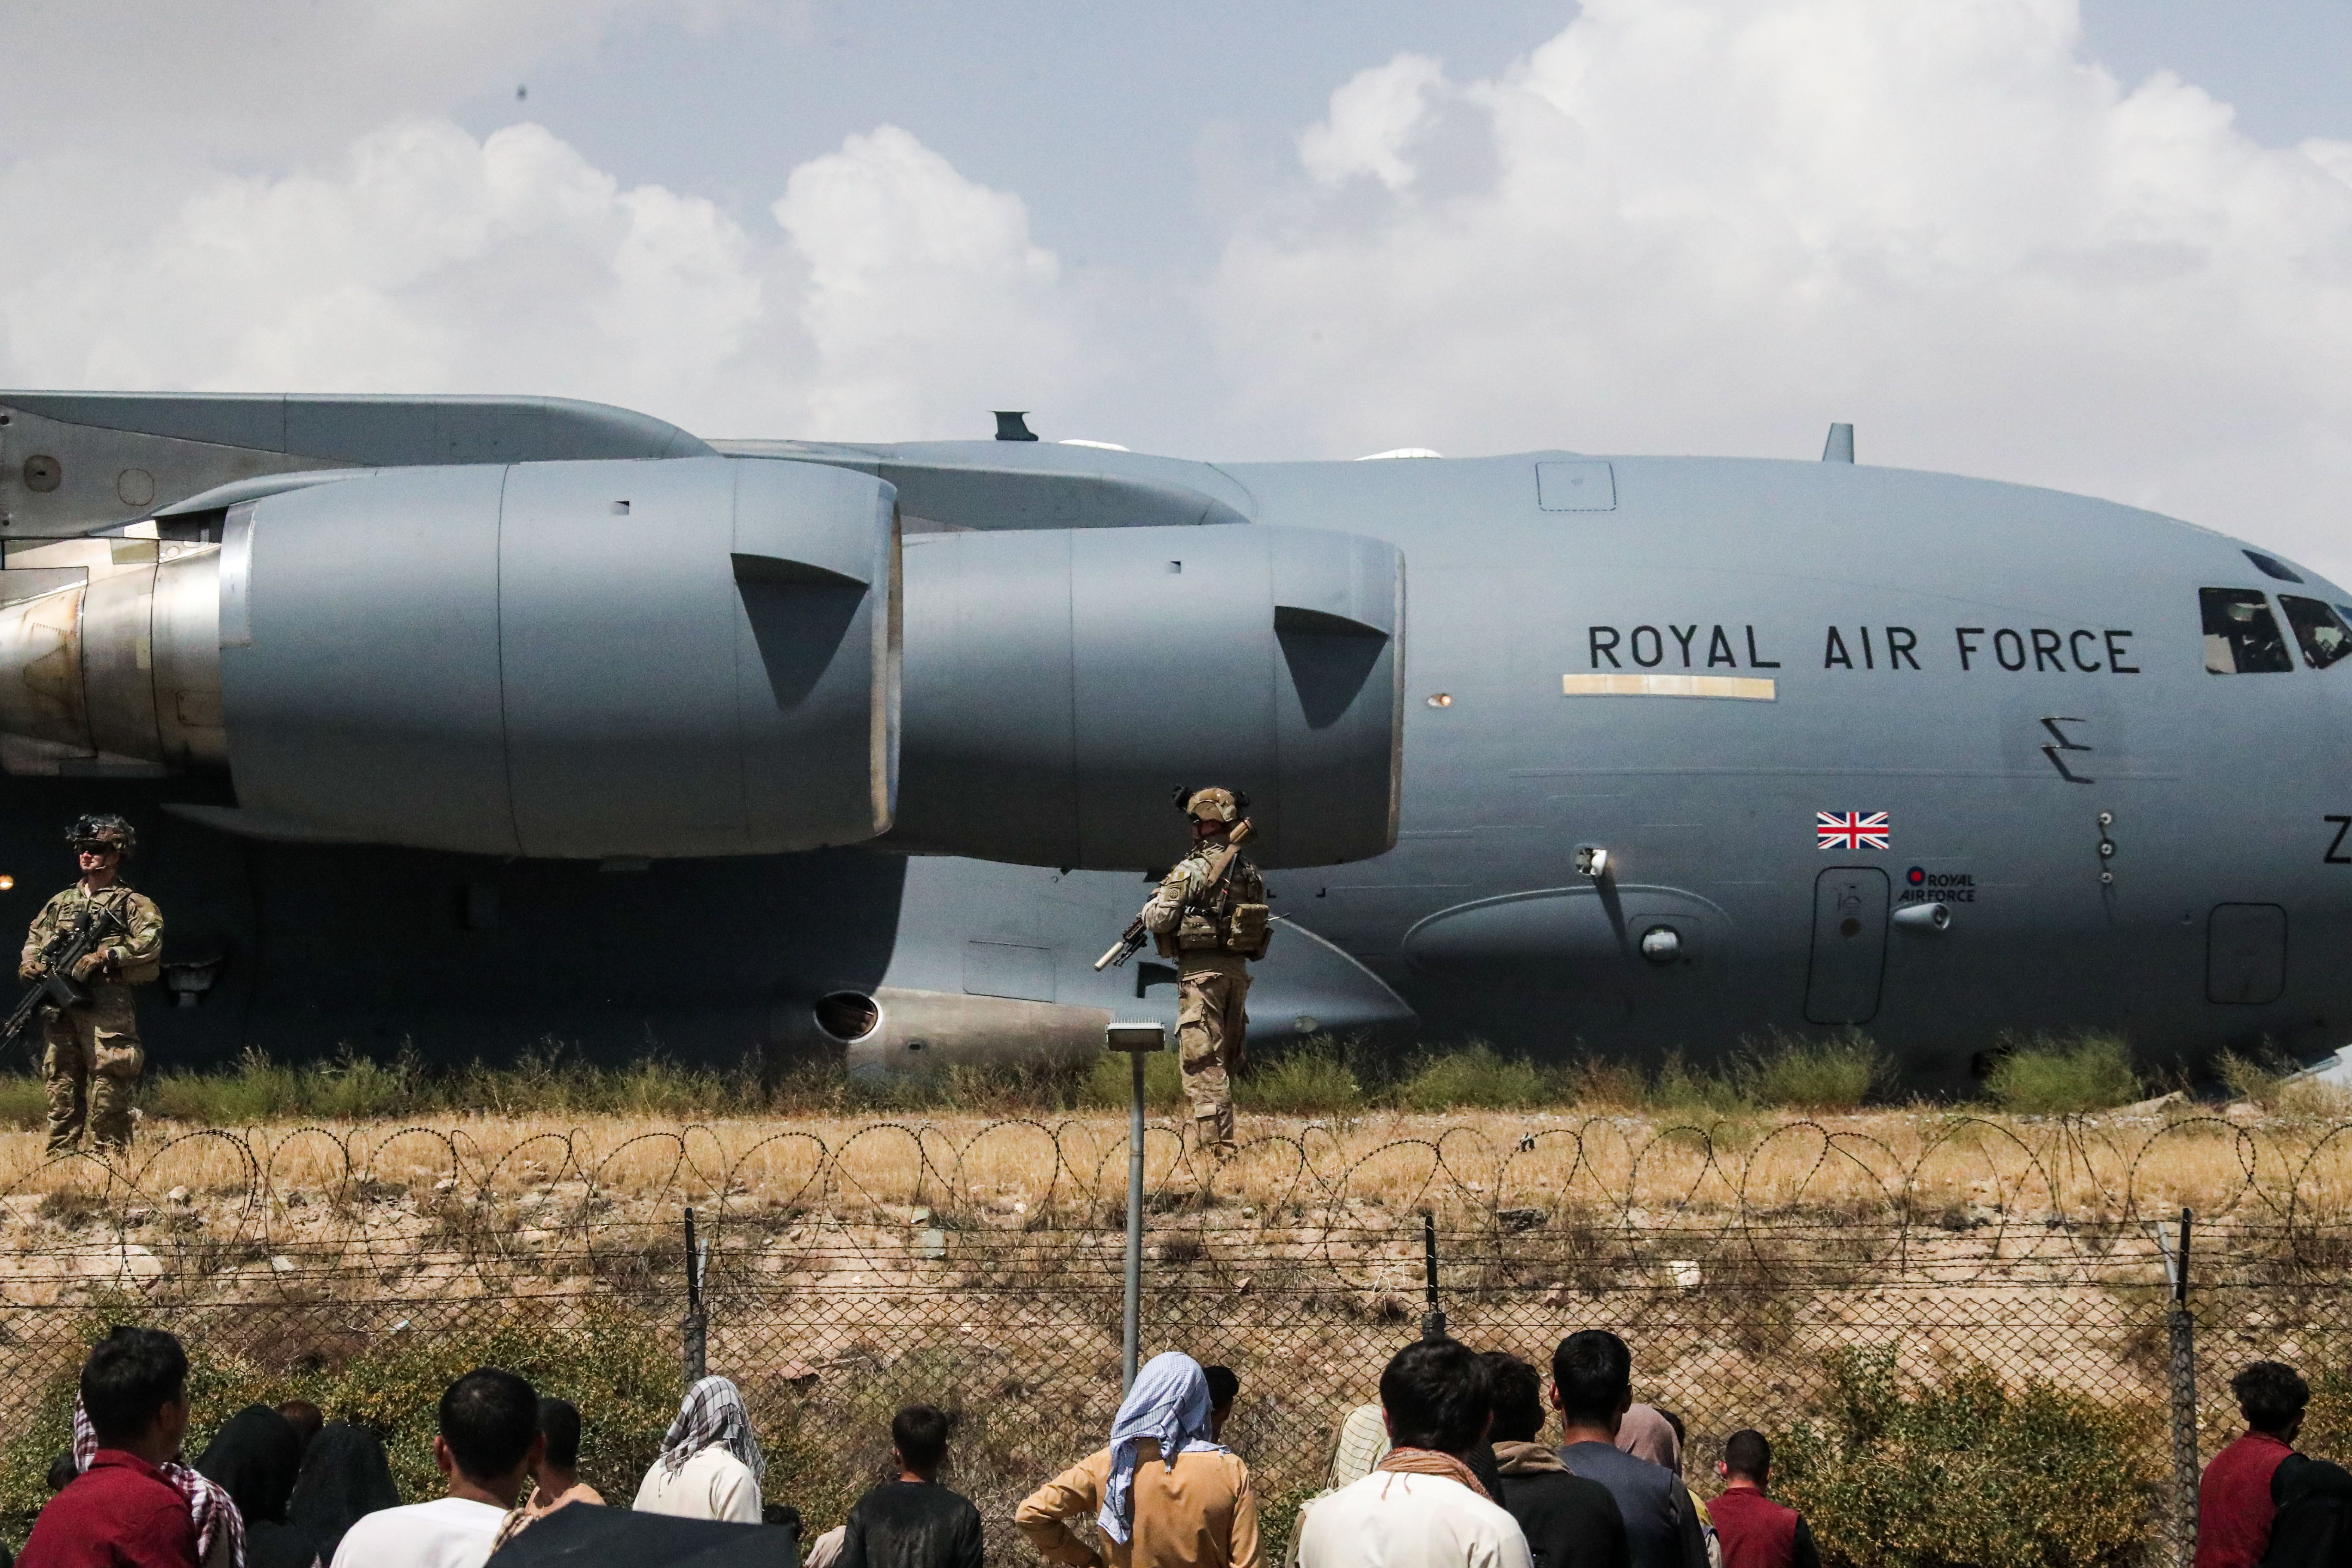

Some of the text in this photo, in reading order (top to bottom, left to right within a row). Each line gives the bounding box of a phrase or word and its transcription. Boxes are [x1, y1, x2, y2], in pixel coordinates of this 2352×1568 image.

[1589, 625, 2140, 674] ROYAL AIR FORCE
[2323, 815, 2352, 864] Z
[1898, 889, 1975, 902] AIR FORCE
[1928, 874, 1975, 887] ROYAL
